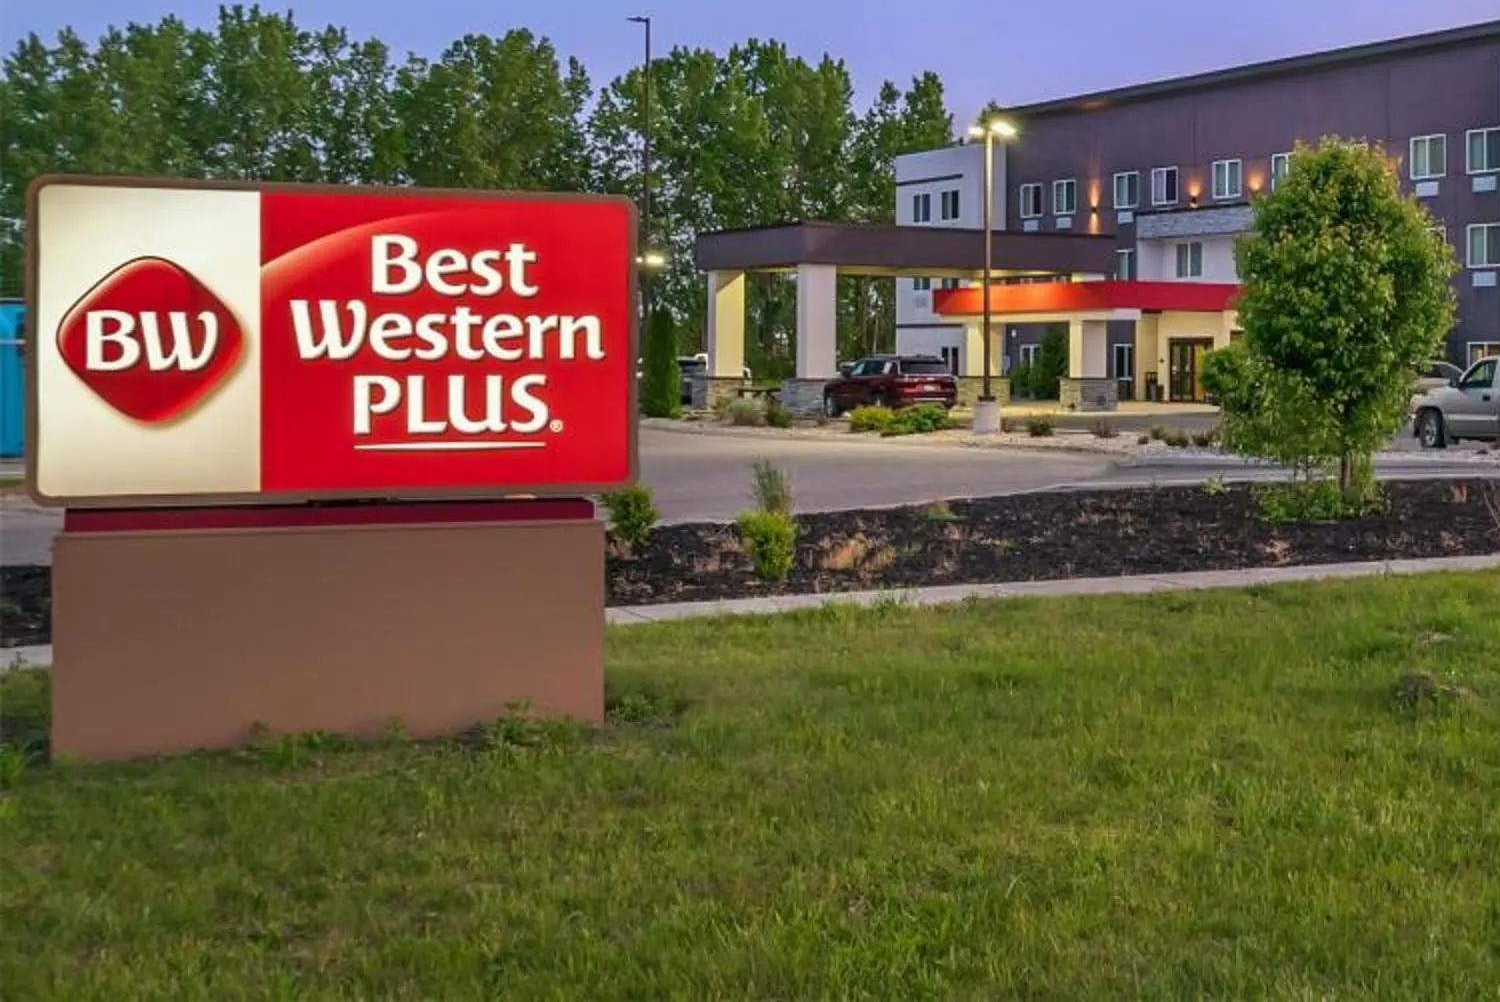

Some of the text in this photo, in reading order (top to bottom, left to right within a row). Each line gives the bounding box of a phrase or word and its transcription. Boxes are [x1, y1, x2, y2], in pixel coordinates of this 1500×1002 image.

[371, 233, 539, 297] Best
[86, 309, 218, 371] BW
[290, 299, 605, 360] Western
